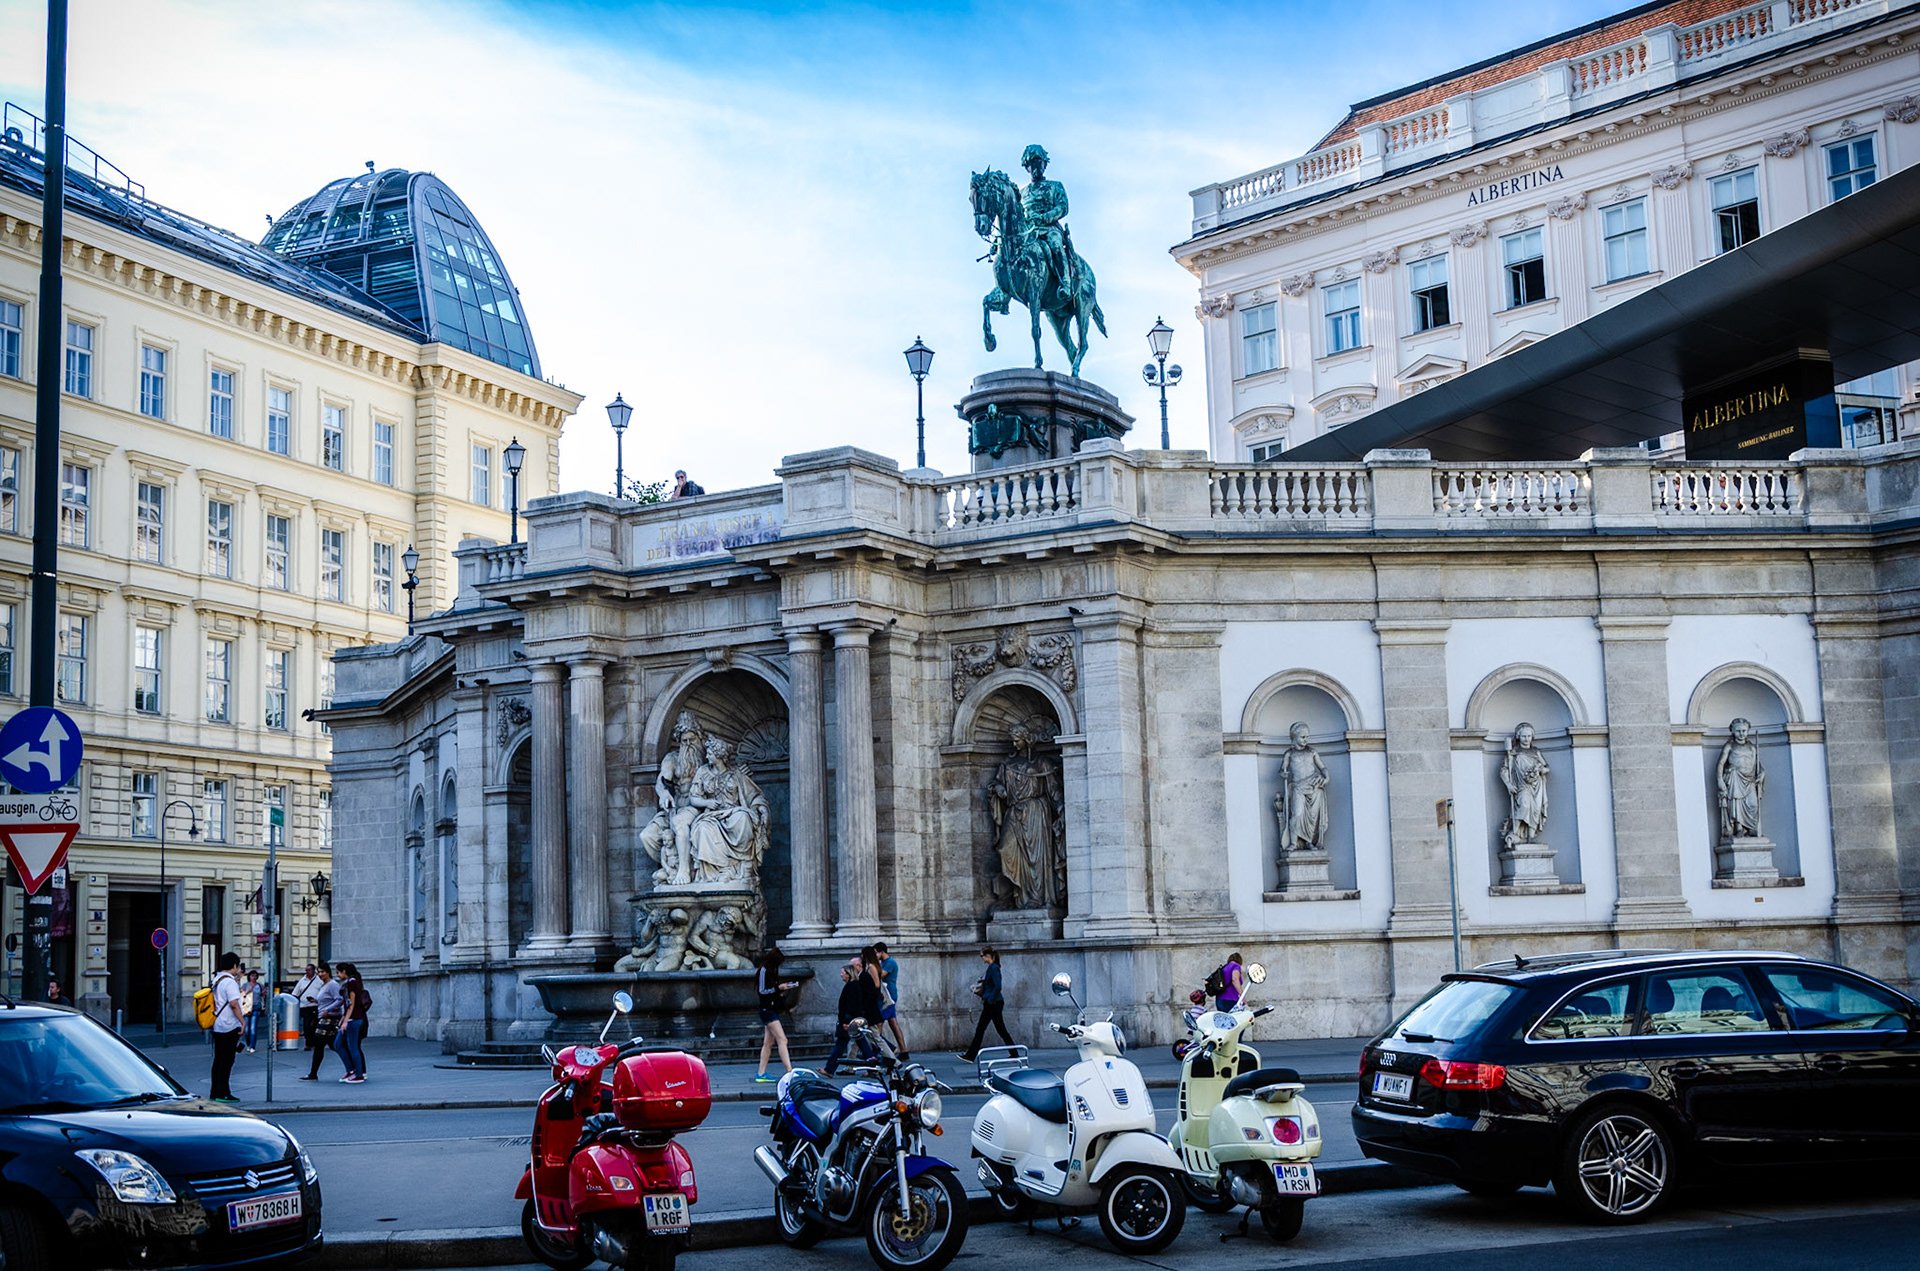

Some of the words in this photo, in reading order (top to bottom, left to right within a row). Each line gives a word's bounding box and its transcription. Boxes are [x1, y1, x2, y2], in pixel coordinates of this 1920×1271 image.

[1466, 164, 1565, 207] ALBERTINA
[1692, 382, 1790, 433] ALBERTINA
[658, 520, 709, 543] FRANZ
[715, 512, 761, 536] JOSEF
[646, 545, 671, 561] DER
[674, 539, 718, 557] STADT
[721, 532, 754, 549] WIEN
[1283, 1166, 1299, 1178] MD
[1282, 1180, 1289, 1191] 1
[1290, 1179, 1311, 1191] RSN
[655, 1196, 671, 1211] KO
[652, 1211, 659, 1226] 1
[661, 1211, 683, 1226] RGF
